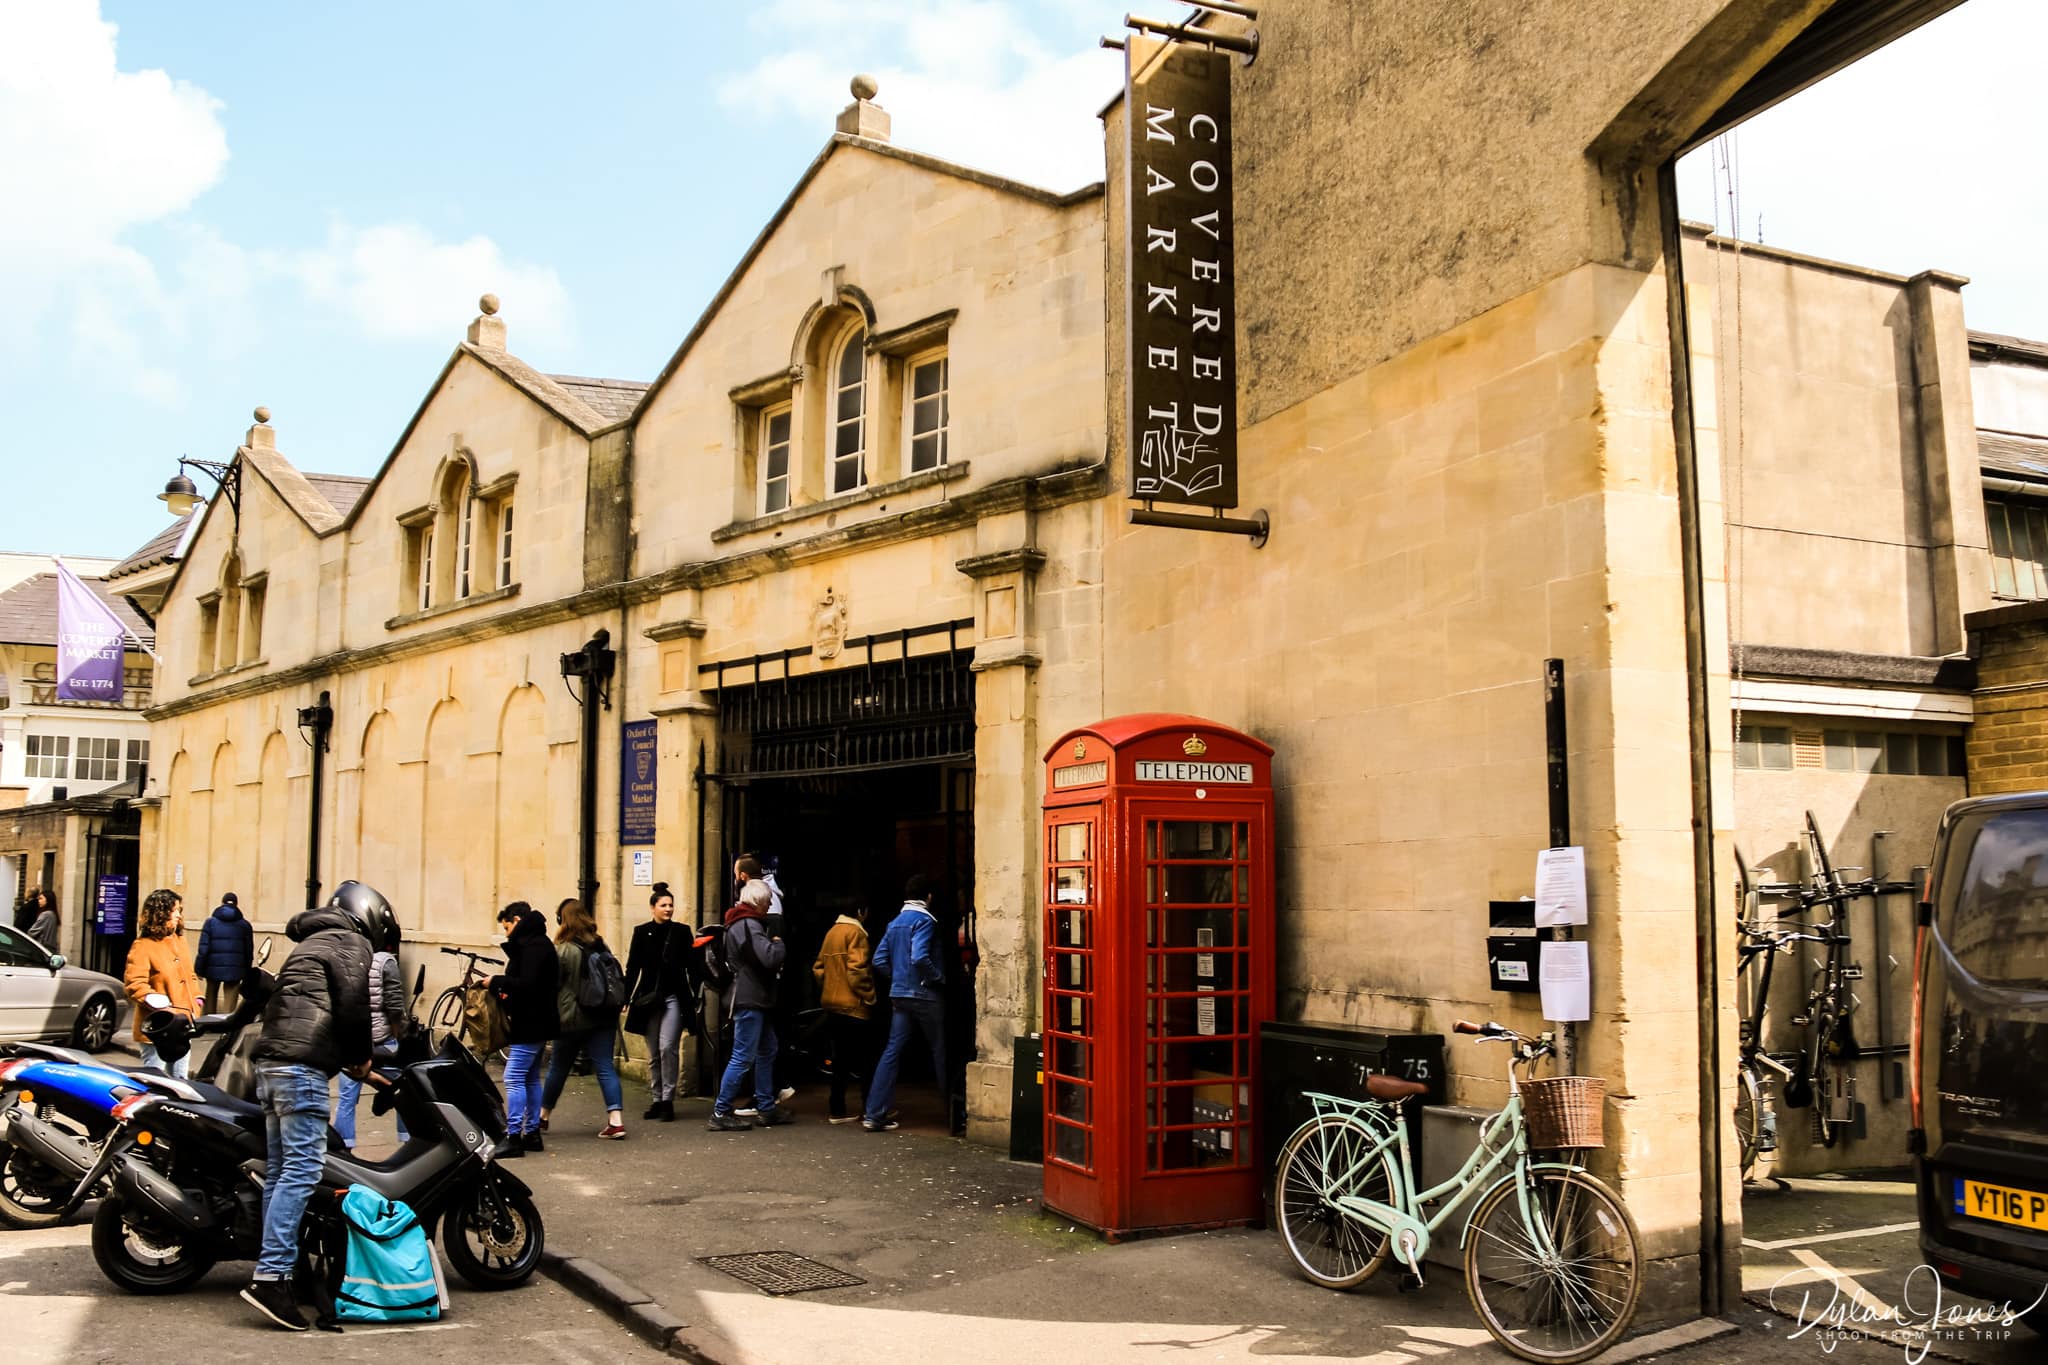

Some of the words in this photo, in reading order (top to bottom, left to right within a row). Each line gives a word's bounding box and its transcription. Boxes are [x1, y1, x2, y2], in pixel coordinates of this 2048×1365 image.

[1146, 102, 1178, 429] MARKET
[1188, 113, 1222, 436] COVERED
[80, 622, 105, 633] THE
[62, 633, 121, 646] COVERED
[65, 647, 118, 659] MARKET
[91, 679, 114, 689] 1774
[1139, 762, 1249, 781] TELEPHONE
[631, 794, 653, 804] Market
[1937, 1091, 2001, 1107] TRANSIT
[1973, 1185, 2023, 1220] YT16
